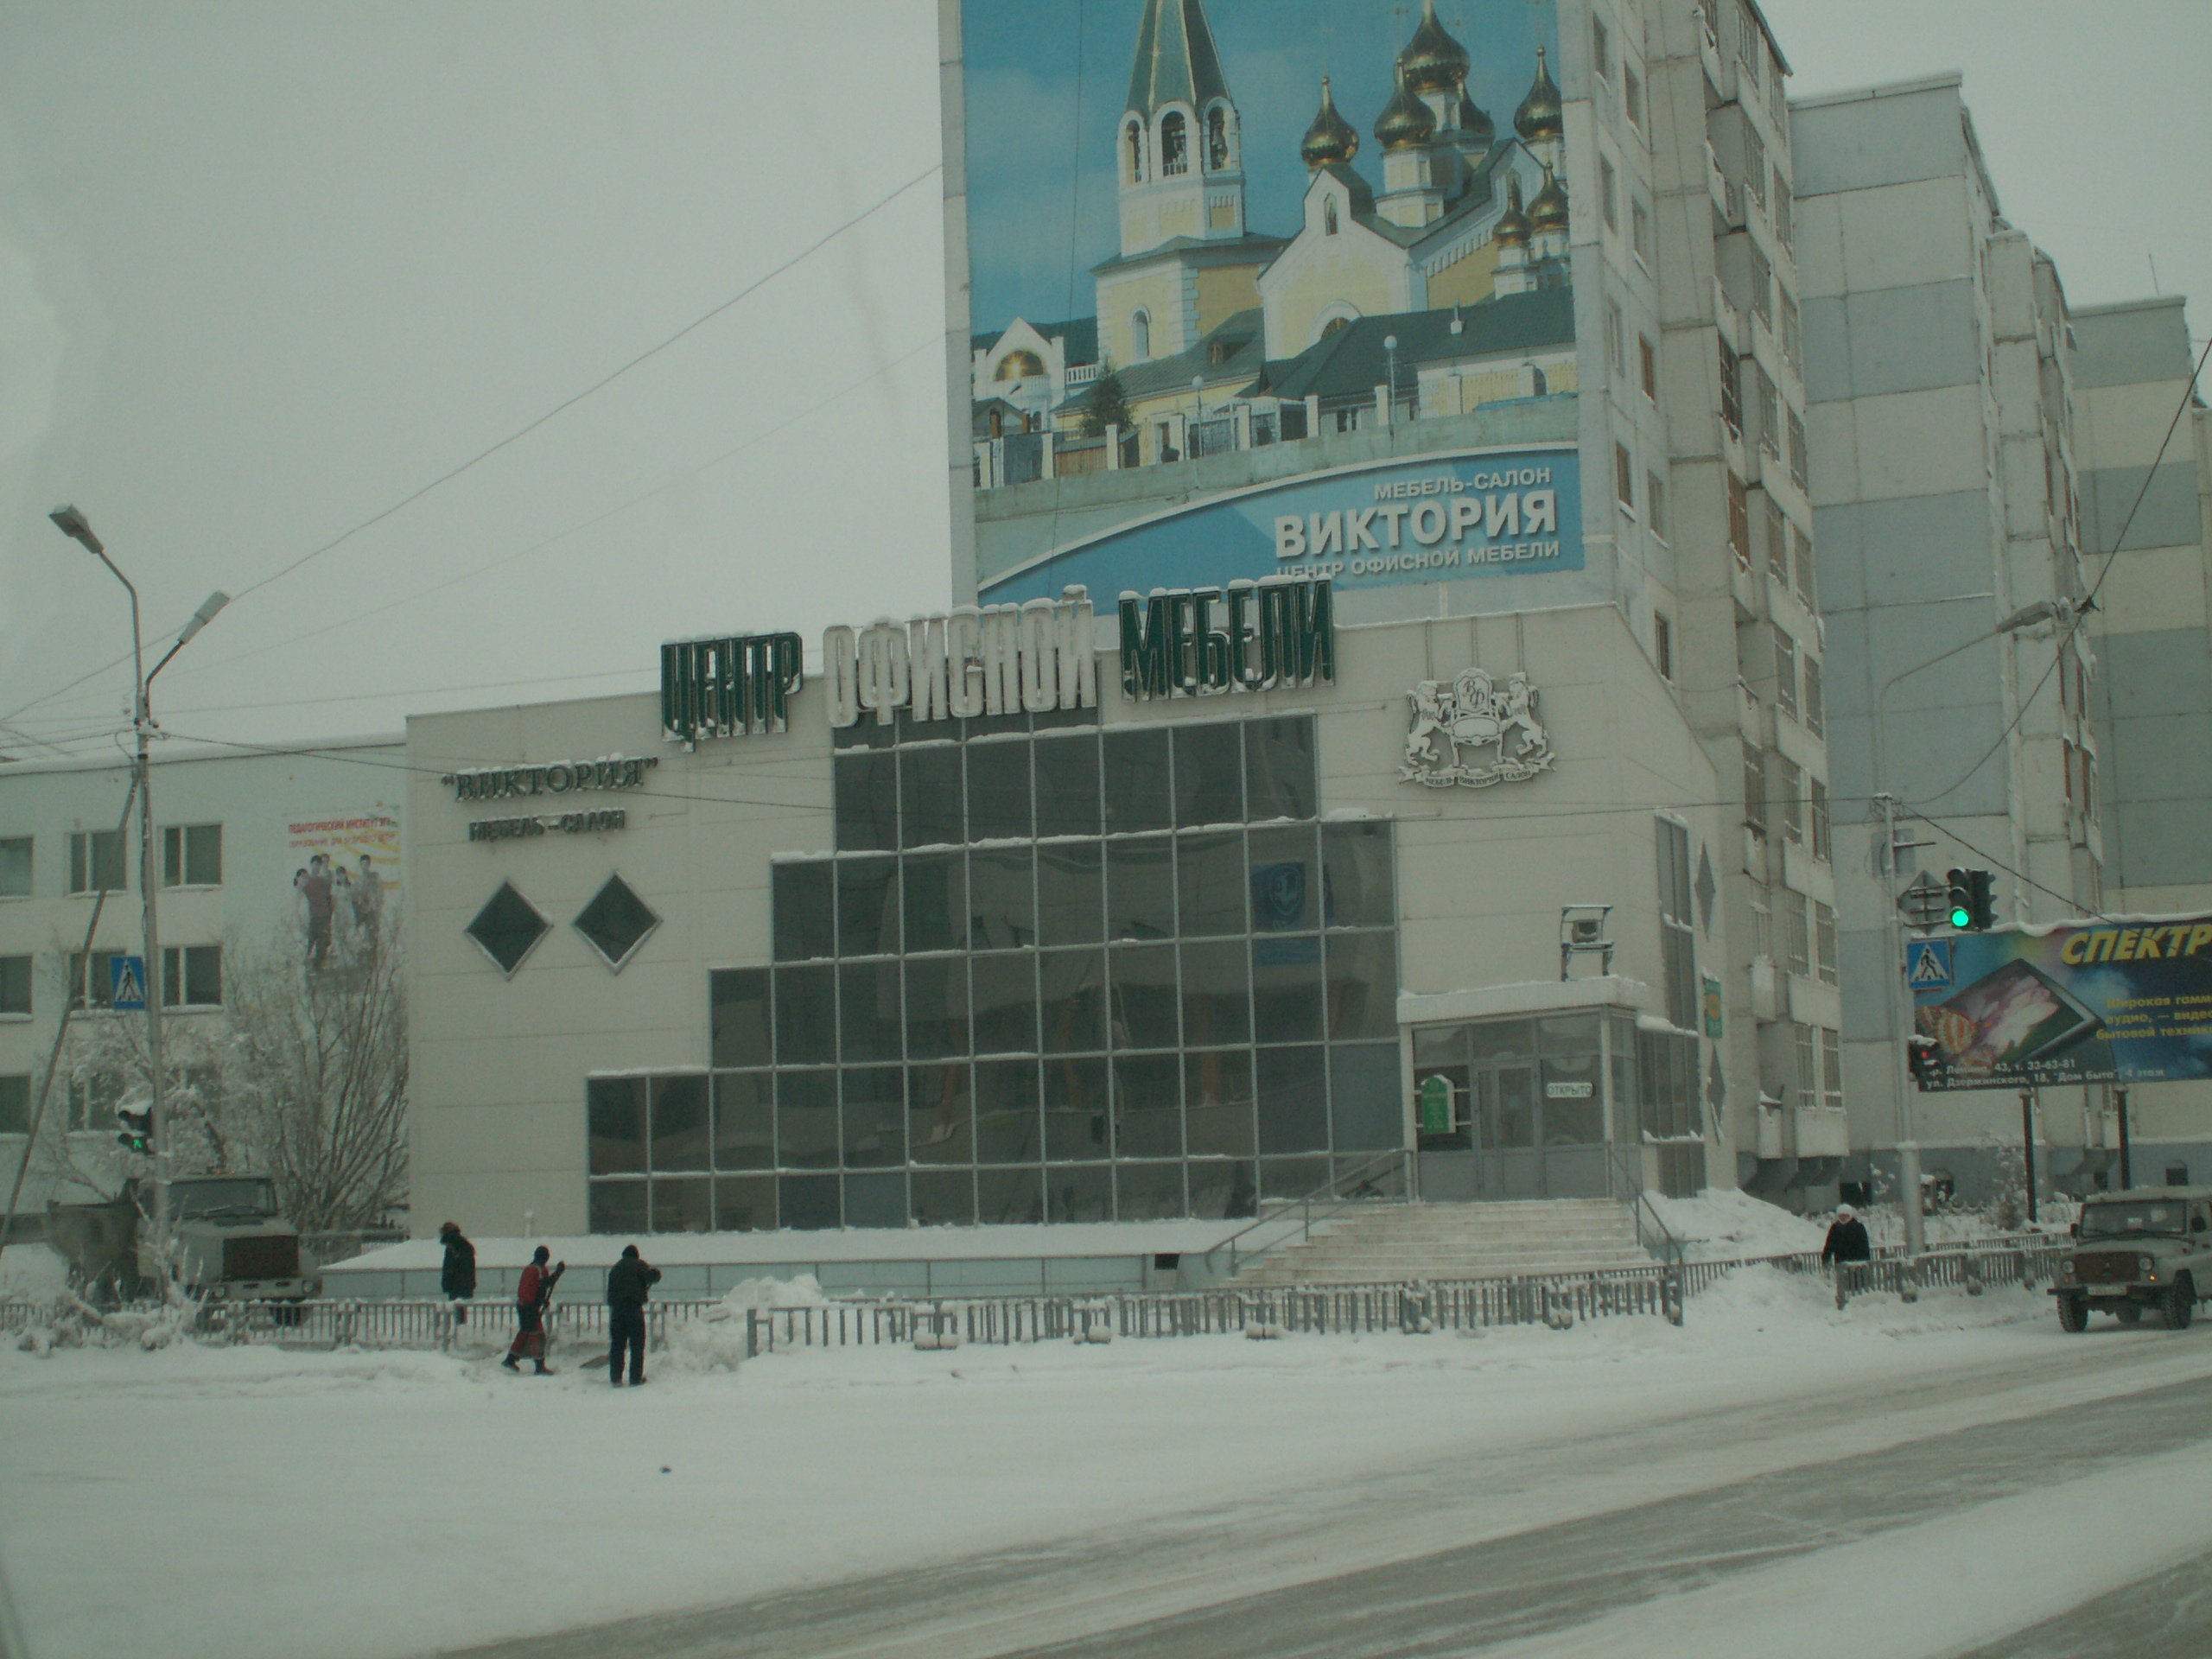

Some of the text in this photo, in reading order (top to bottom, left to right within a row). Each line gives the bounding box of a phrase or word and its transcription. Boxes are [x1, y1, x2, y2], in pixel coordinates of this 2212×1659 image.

[1375, 467, 1551, 499] МЕБЕЛЬ-САЛОН
[1274, 489, 1556, 558] ВИКТОРИЯ
[1276, 540, 1560, 579] ЦЕНТР ОФИСНОЙ МЕБЕЛИ
[660, 578, 1336, 753] ЦЕНТР ОФИСНОЙ МЕБЕЛИ
[2062, 924, 2212, 965] СПЕКТР
[2106, 995, 2212, 1010] Широкая гамм
[2096, 1027, 2212, 1040] бытовой техник
[1548, 1085, 1592, 1096] ОТКРЫТО
[1947, 1076, 2031, 1089] Дзержинского,
